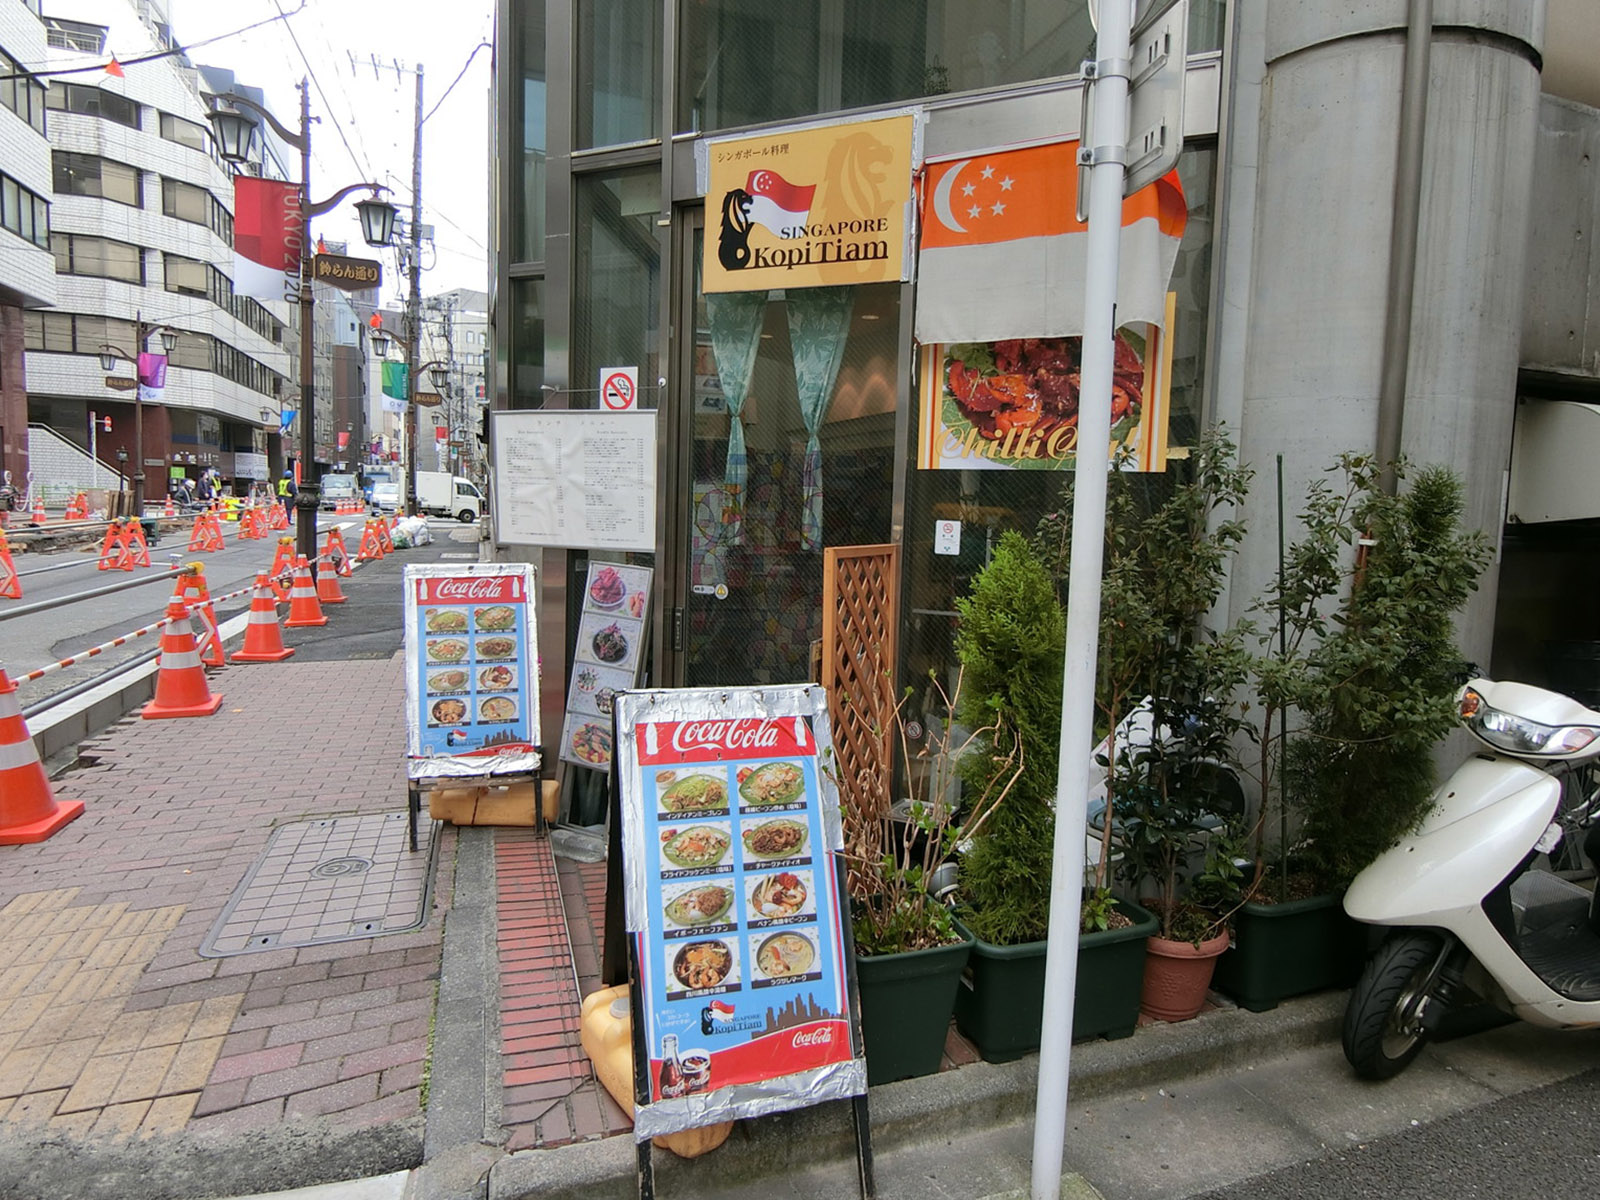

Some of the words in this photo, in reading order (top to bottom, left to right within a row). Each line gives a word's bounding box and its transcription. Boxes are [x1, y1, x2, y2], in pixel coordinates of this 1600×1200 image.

[717, 143, 789, 163] シンガポール料理
[780, 217, 889, 240] SINGAPORE
[284, 252, 301, 305] 2020
[319, 260, 378, 282] 鈴らん通り
[934, 426, 1043, 460] Chilli
[1047, 425, 1144, 461] Cb
[436, 577, 505, 599] Coca-Cola
[672, 717, 779, 752] Coca-Cola
[770, 975, 807, 986] ラクサレマーク
[792, 1026, 832, 1048] Coca-Cola
